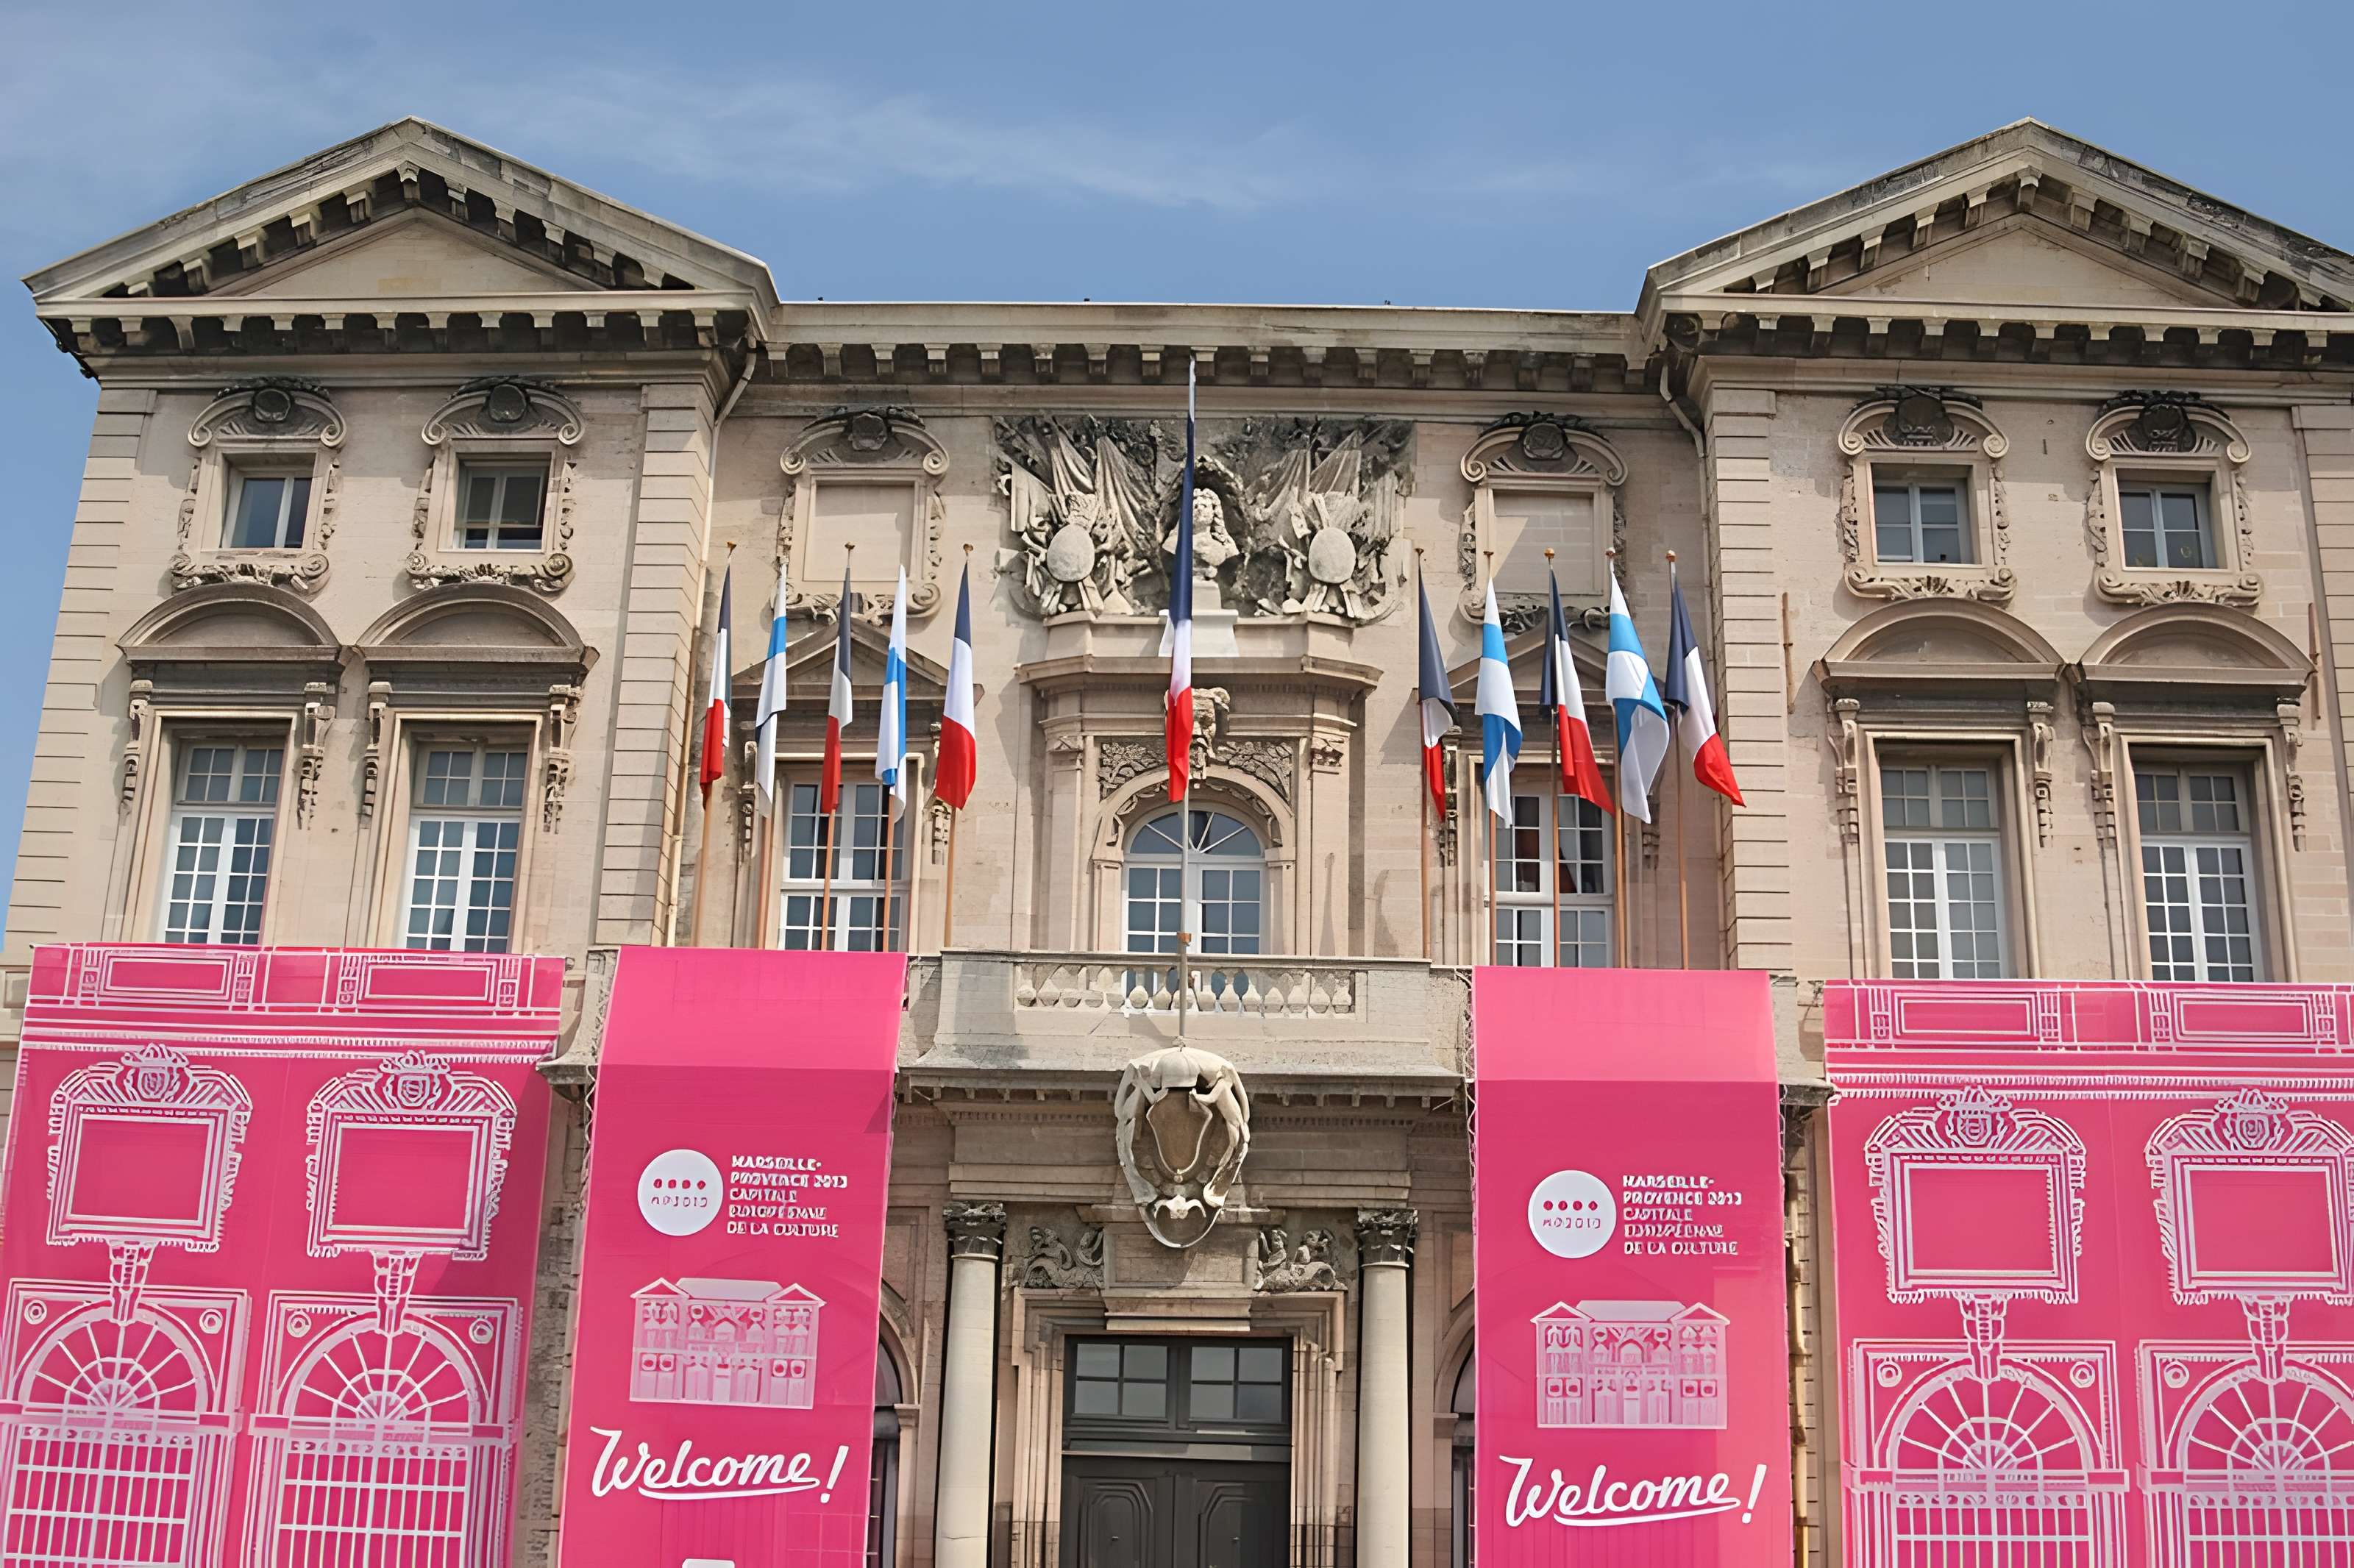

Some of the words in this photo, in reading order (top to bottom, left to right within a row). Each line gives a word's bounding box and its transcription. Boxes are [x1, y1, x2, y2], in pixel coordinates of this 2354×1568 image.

[727, 1221, 747, 1234] DE
[750, 1222, 769, 1235] LA
[1624, 1241, 1643, 1255] DE
[1647, 1241, 1666, 1255] LA
